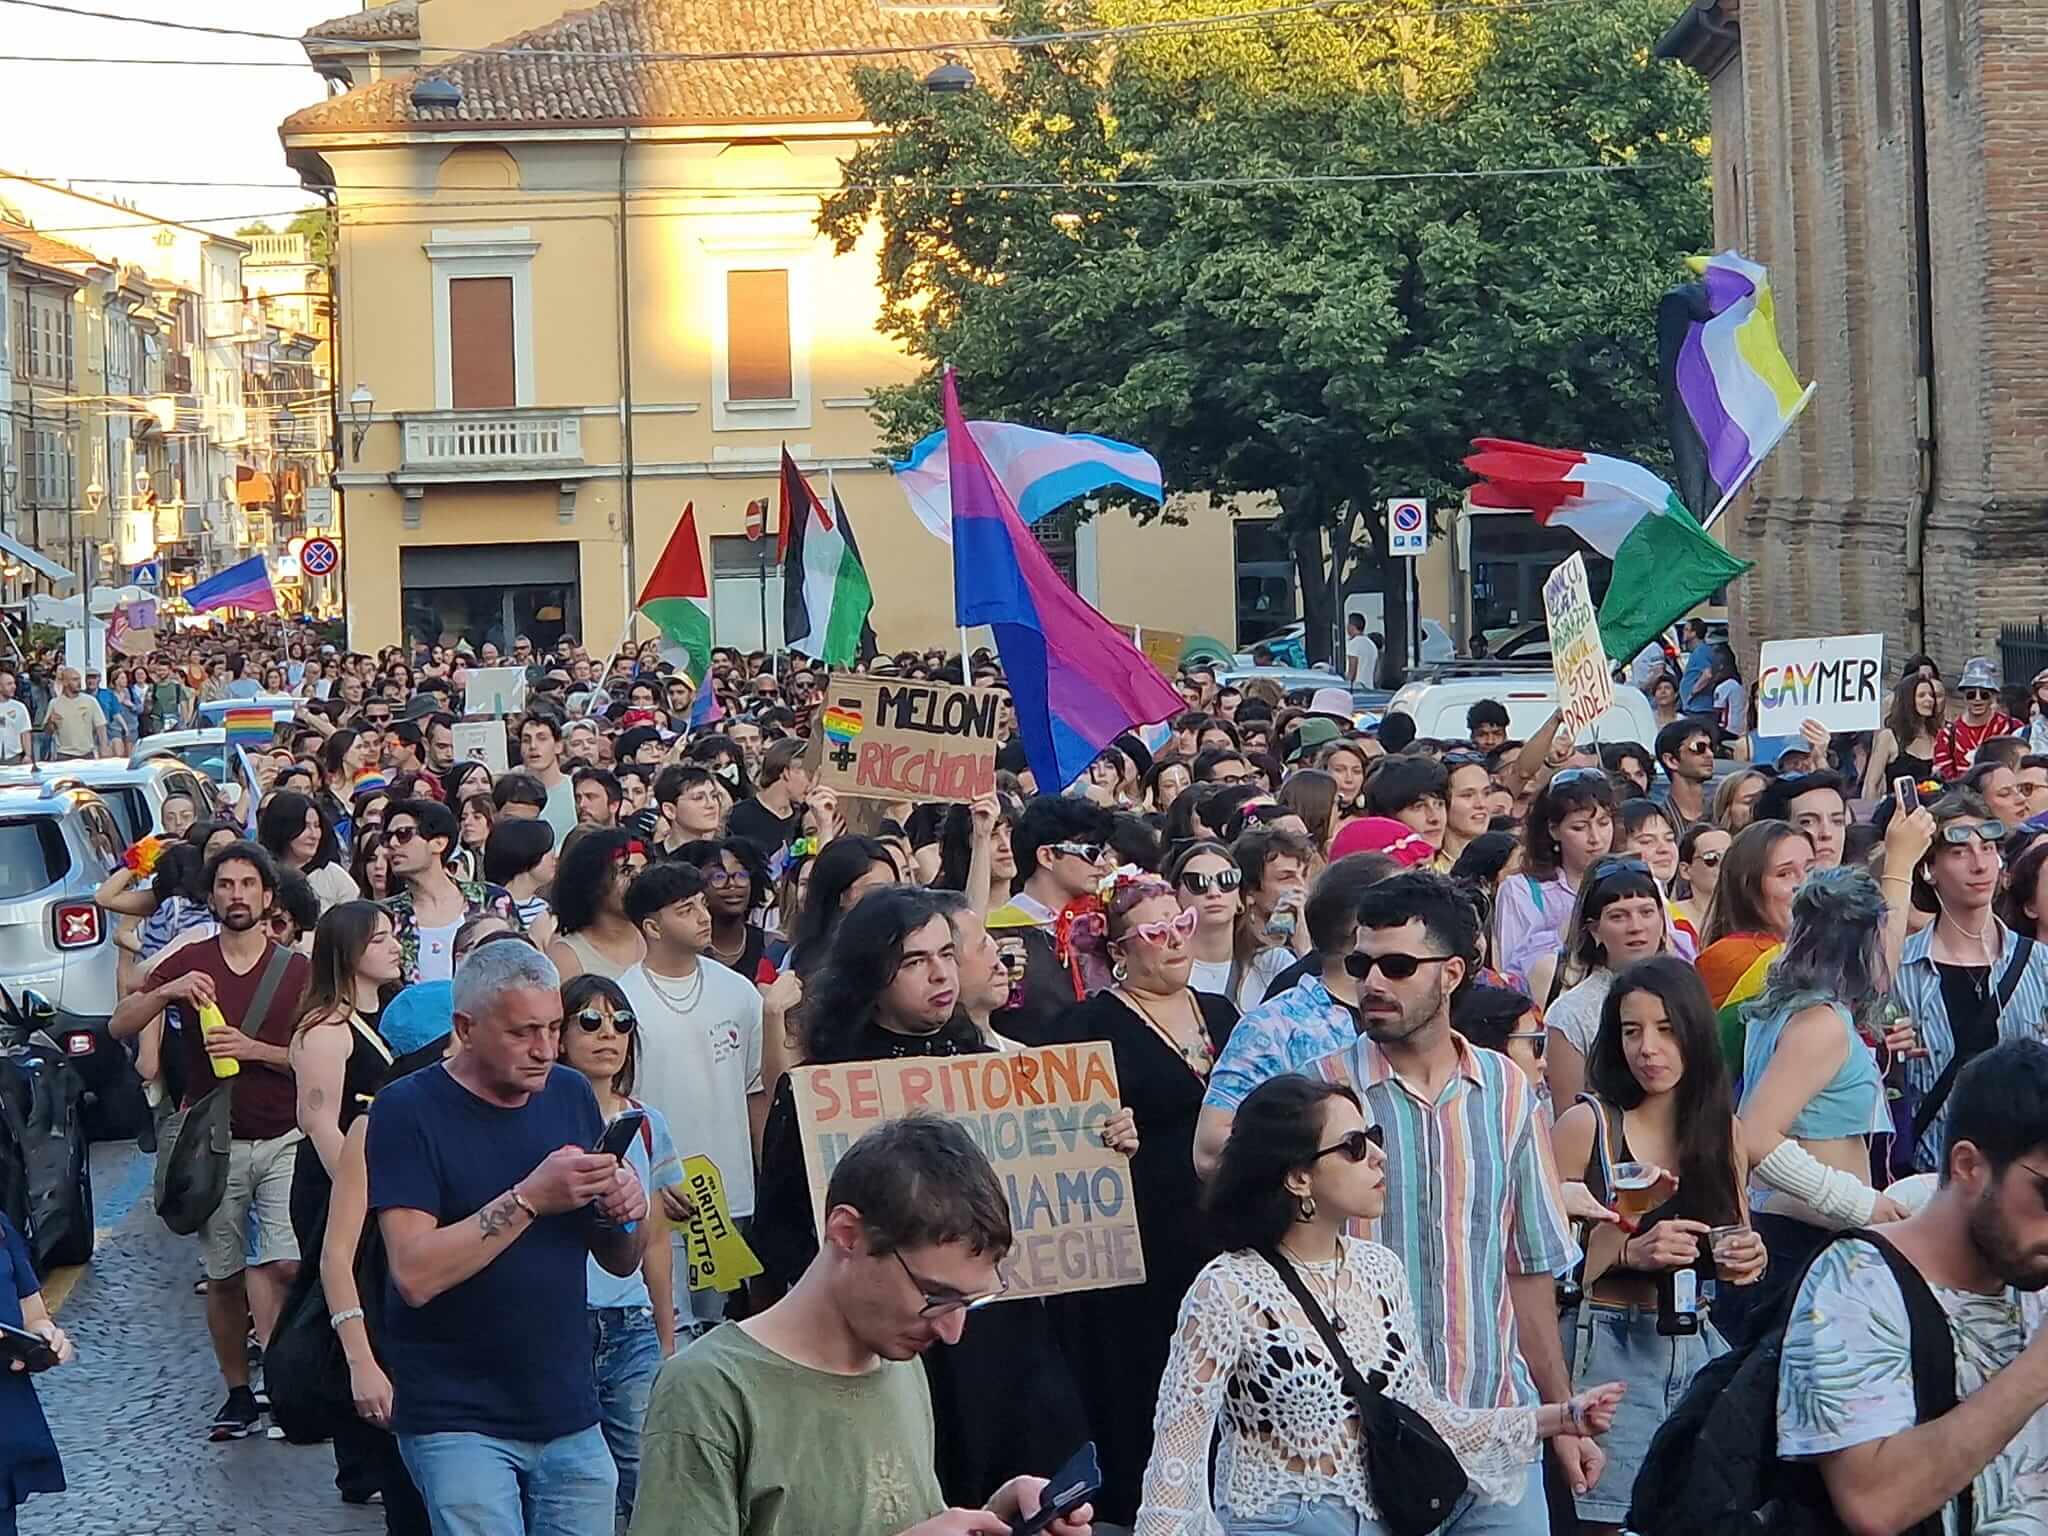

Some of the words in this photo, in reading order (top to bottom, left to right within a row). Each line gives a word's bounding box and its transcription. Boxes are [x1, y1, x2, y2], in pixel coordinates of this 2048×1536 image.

[1567, 659, 1594, 697] STO
[1760, 660, 1878, 709] GAYMER
[876, 686, 999, 738] MELONI
[810, 1067, 879, 1122] SE
[900, 1047, 1120, 1114] RITORNA
[691, 1174, 727, 1240] DIRITTI
[1006, 1166, 1124, 1230] IAMO
[1001, 1228, 1142, 1290] REGHE
